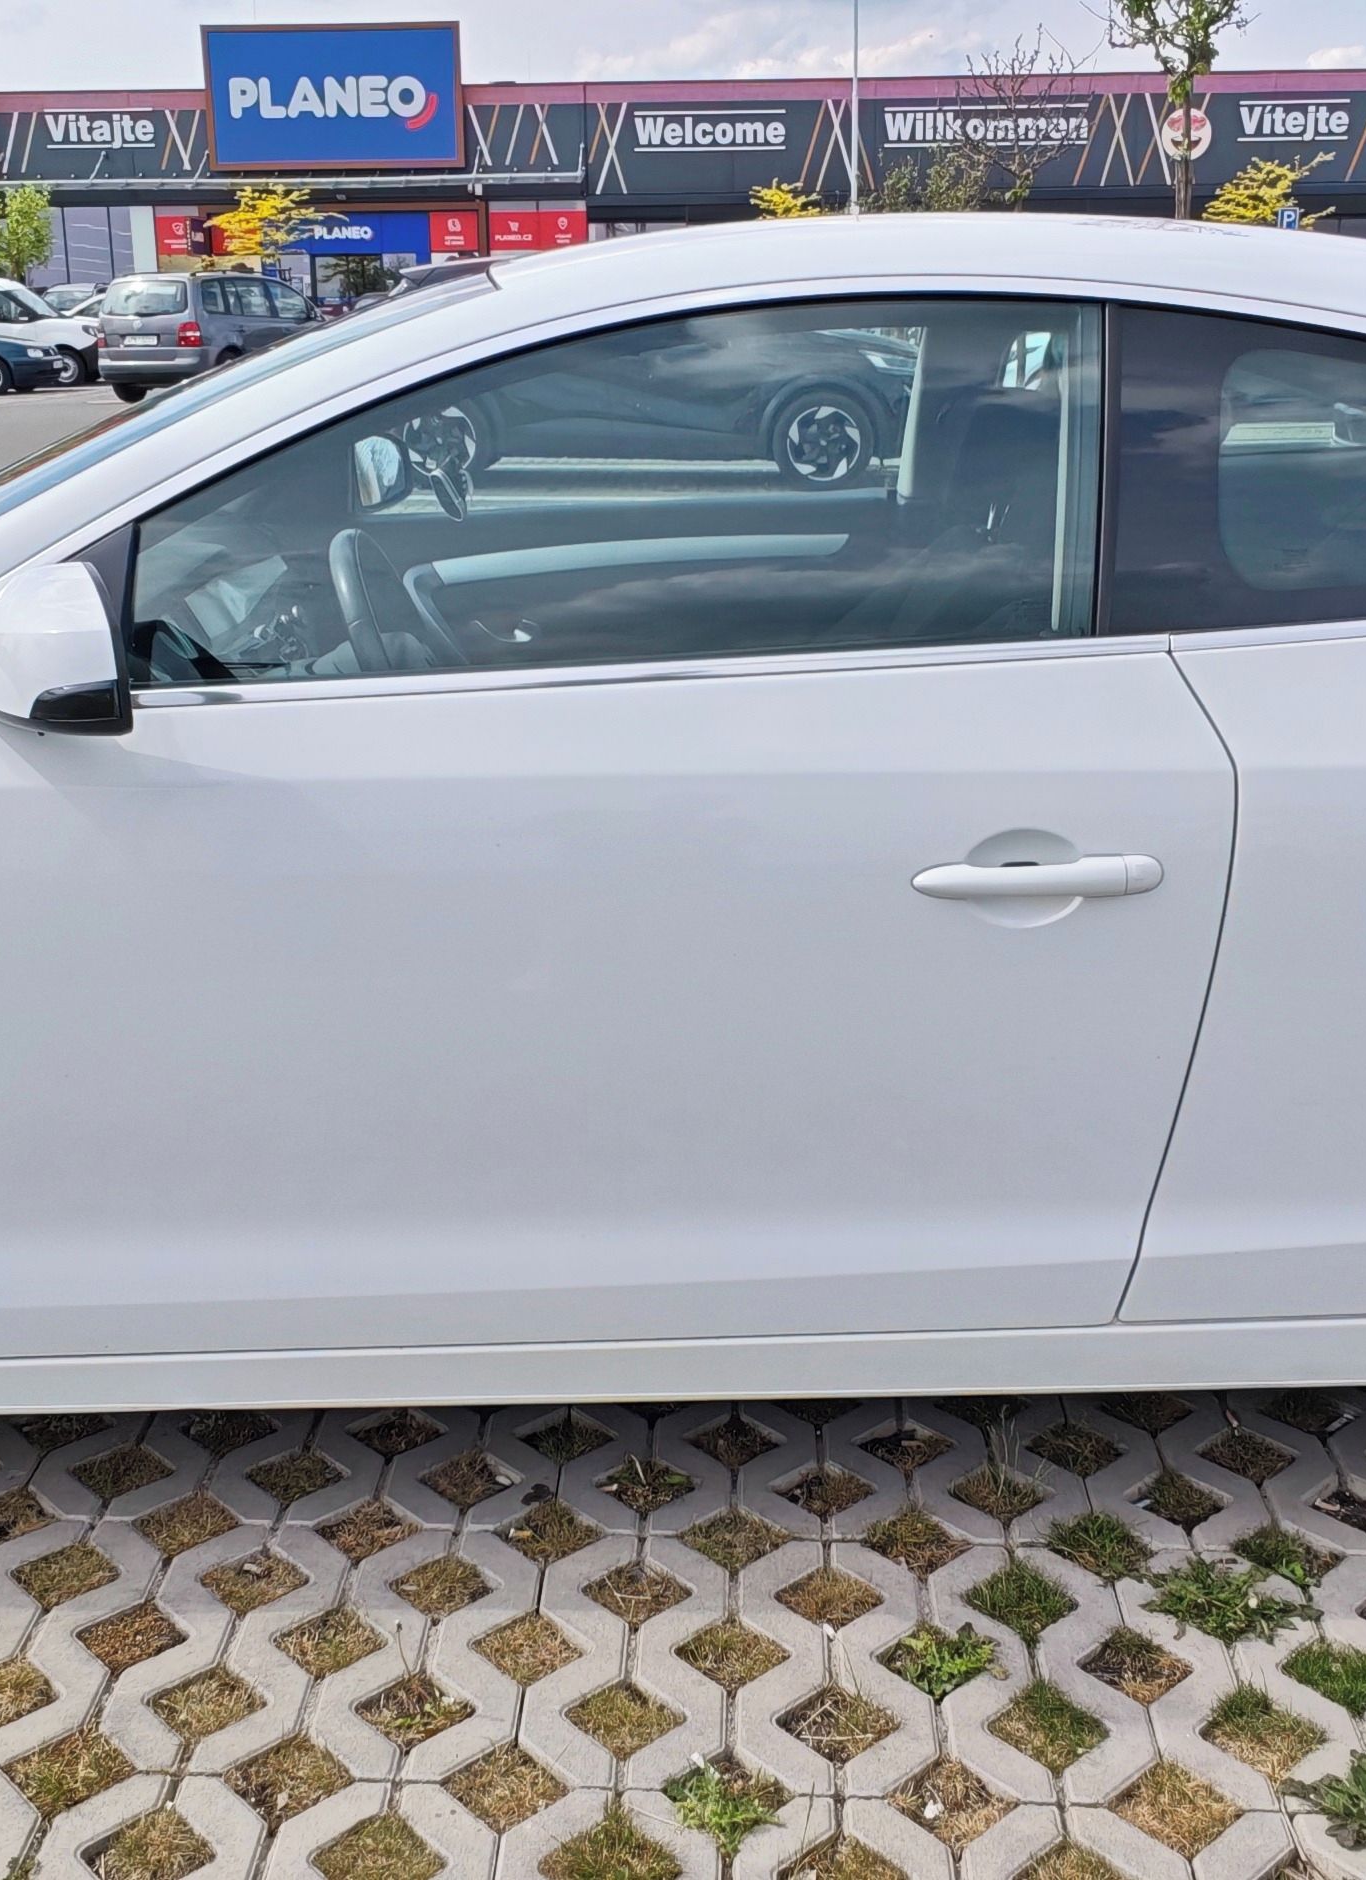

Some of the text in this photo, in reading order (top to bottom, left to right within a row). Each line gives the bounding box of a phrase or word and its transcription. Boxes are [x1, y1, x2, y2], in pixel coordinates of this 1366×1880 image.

[229, 75, 426, 119] PLANEO
[44, 114, 155, 149] Vitajte
[634, 116, 786, 146] Welcome
[885, 112, 1089, 141] Willkommen
[1239, 105, 1350, 141] Vítejte
[315, 226, 373, 241] PLANEO
[1283, 211, 1296, 228] P
